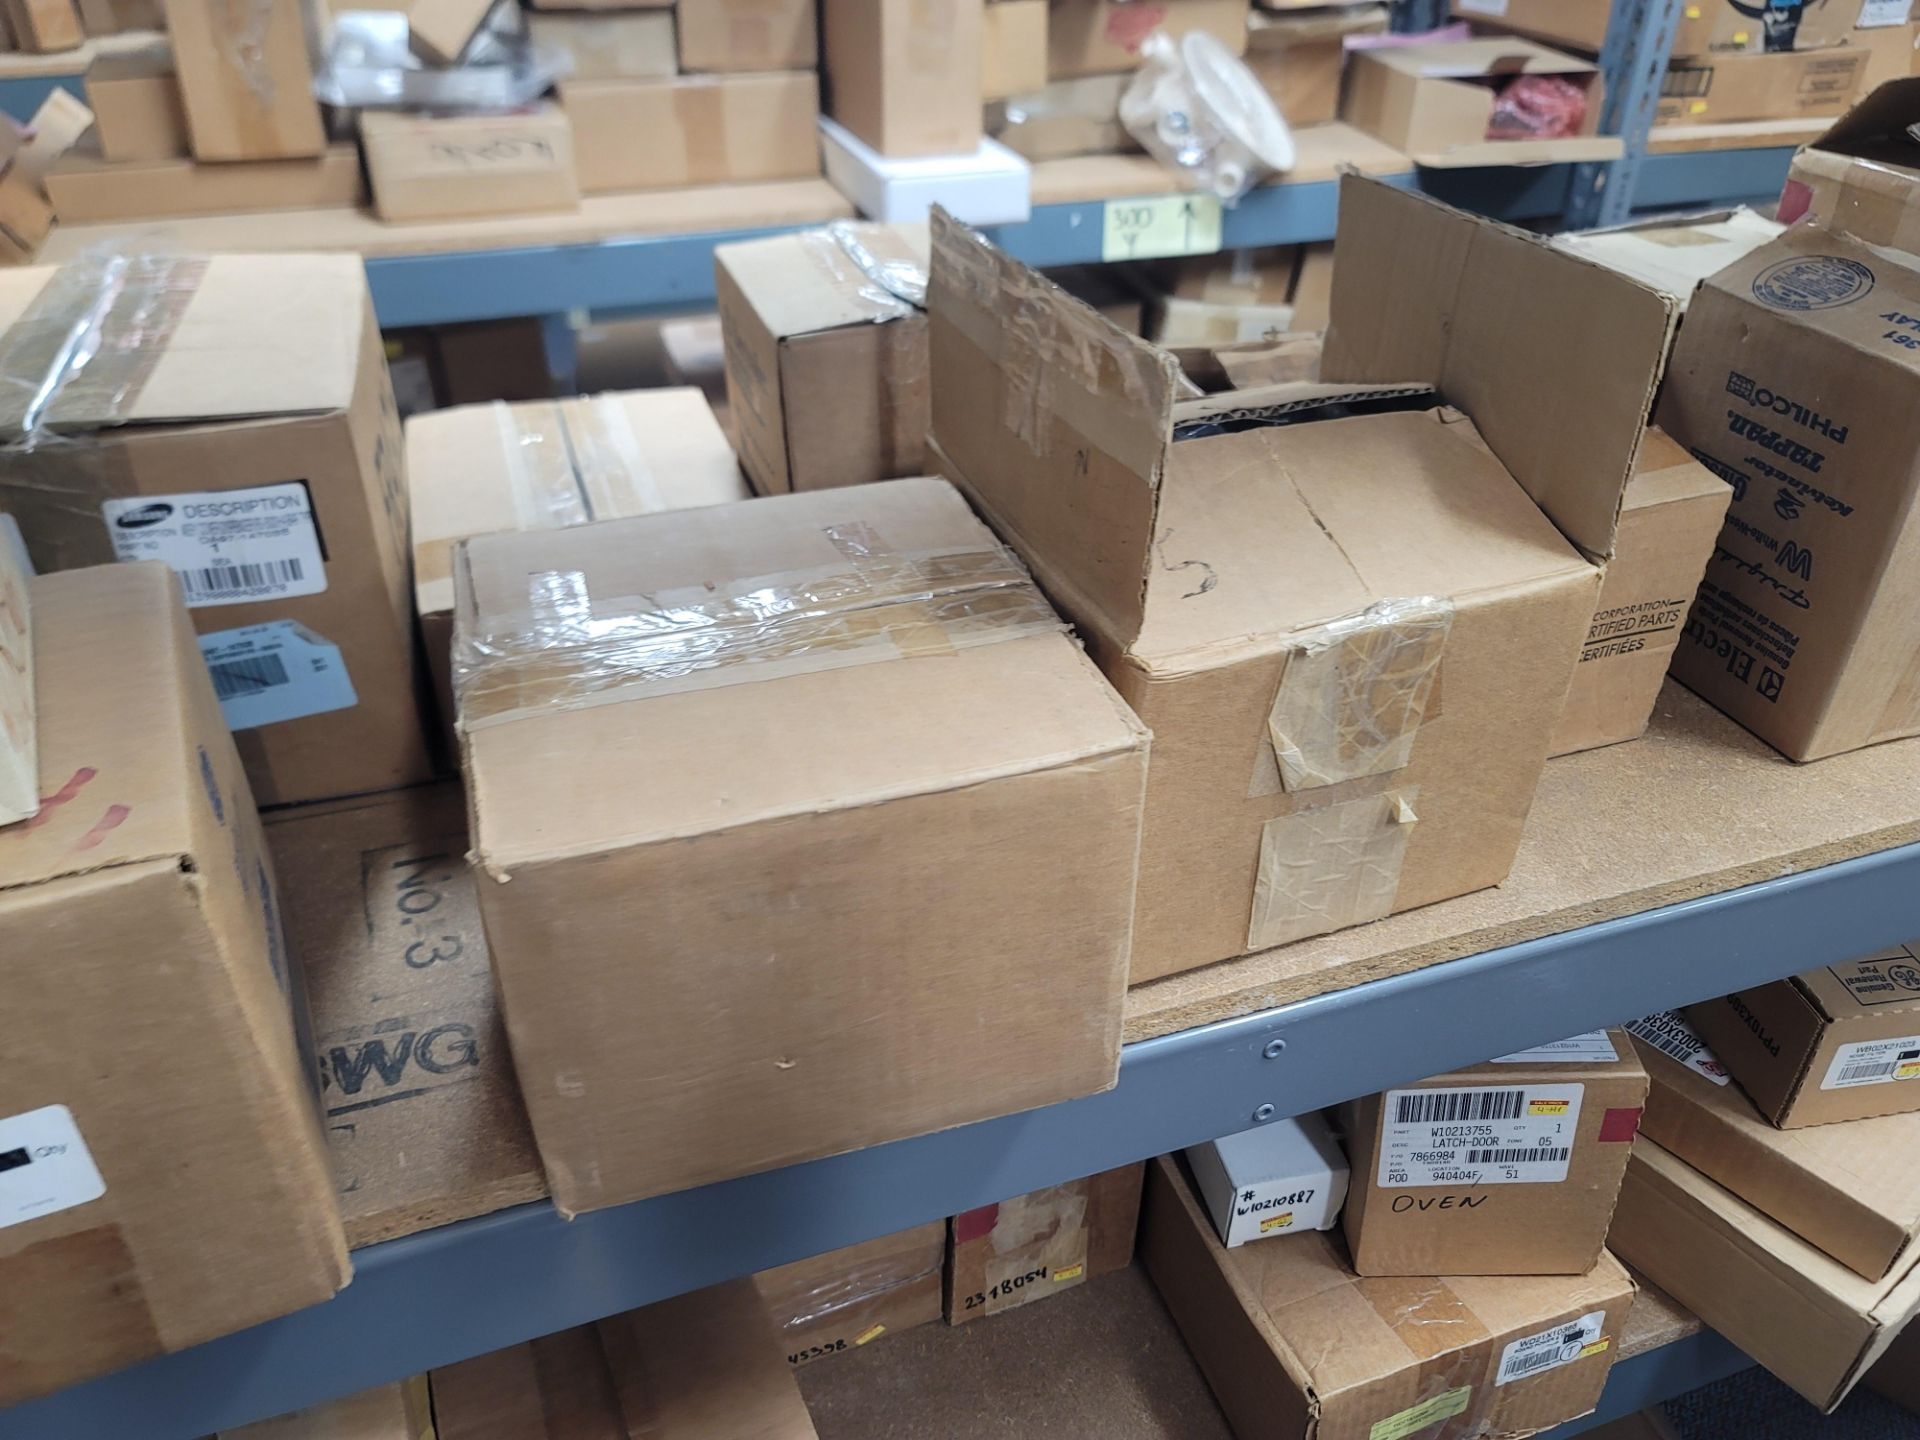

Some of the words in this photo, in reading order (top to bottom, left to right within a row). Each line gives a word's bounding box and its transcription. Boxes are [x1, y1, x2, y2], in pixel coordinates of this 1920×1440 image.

[1755, 389, 1848, 444] PHILCO
[1744, 457, 1854, 517] Kelvinator
[182, 495, 301, 519] DESCRIPTION
[1593, 599, 1671, 621] CORPORATION
[1638, 609, 1680, 628] PARTS
[1579, 638, 1646, 663] ERTIFIÉES
[1431, 1125, 1492, 1137] W10213755
[1555, 1123, 1561, 1133] 1
[1432, 1137, 1499, 1149] LATCH-DOOR
[1538, 1136, 1553, 1146] 05
[1410, 1150, 1456, 1162] 7866984
[1432, 1170, 1479, 1181] 940404F
[1505, 1169, 1519, 1179] 51
[1392, 1194, 1488, 1214] OVEN
